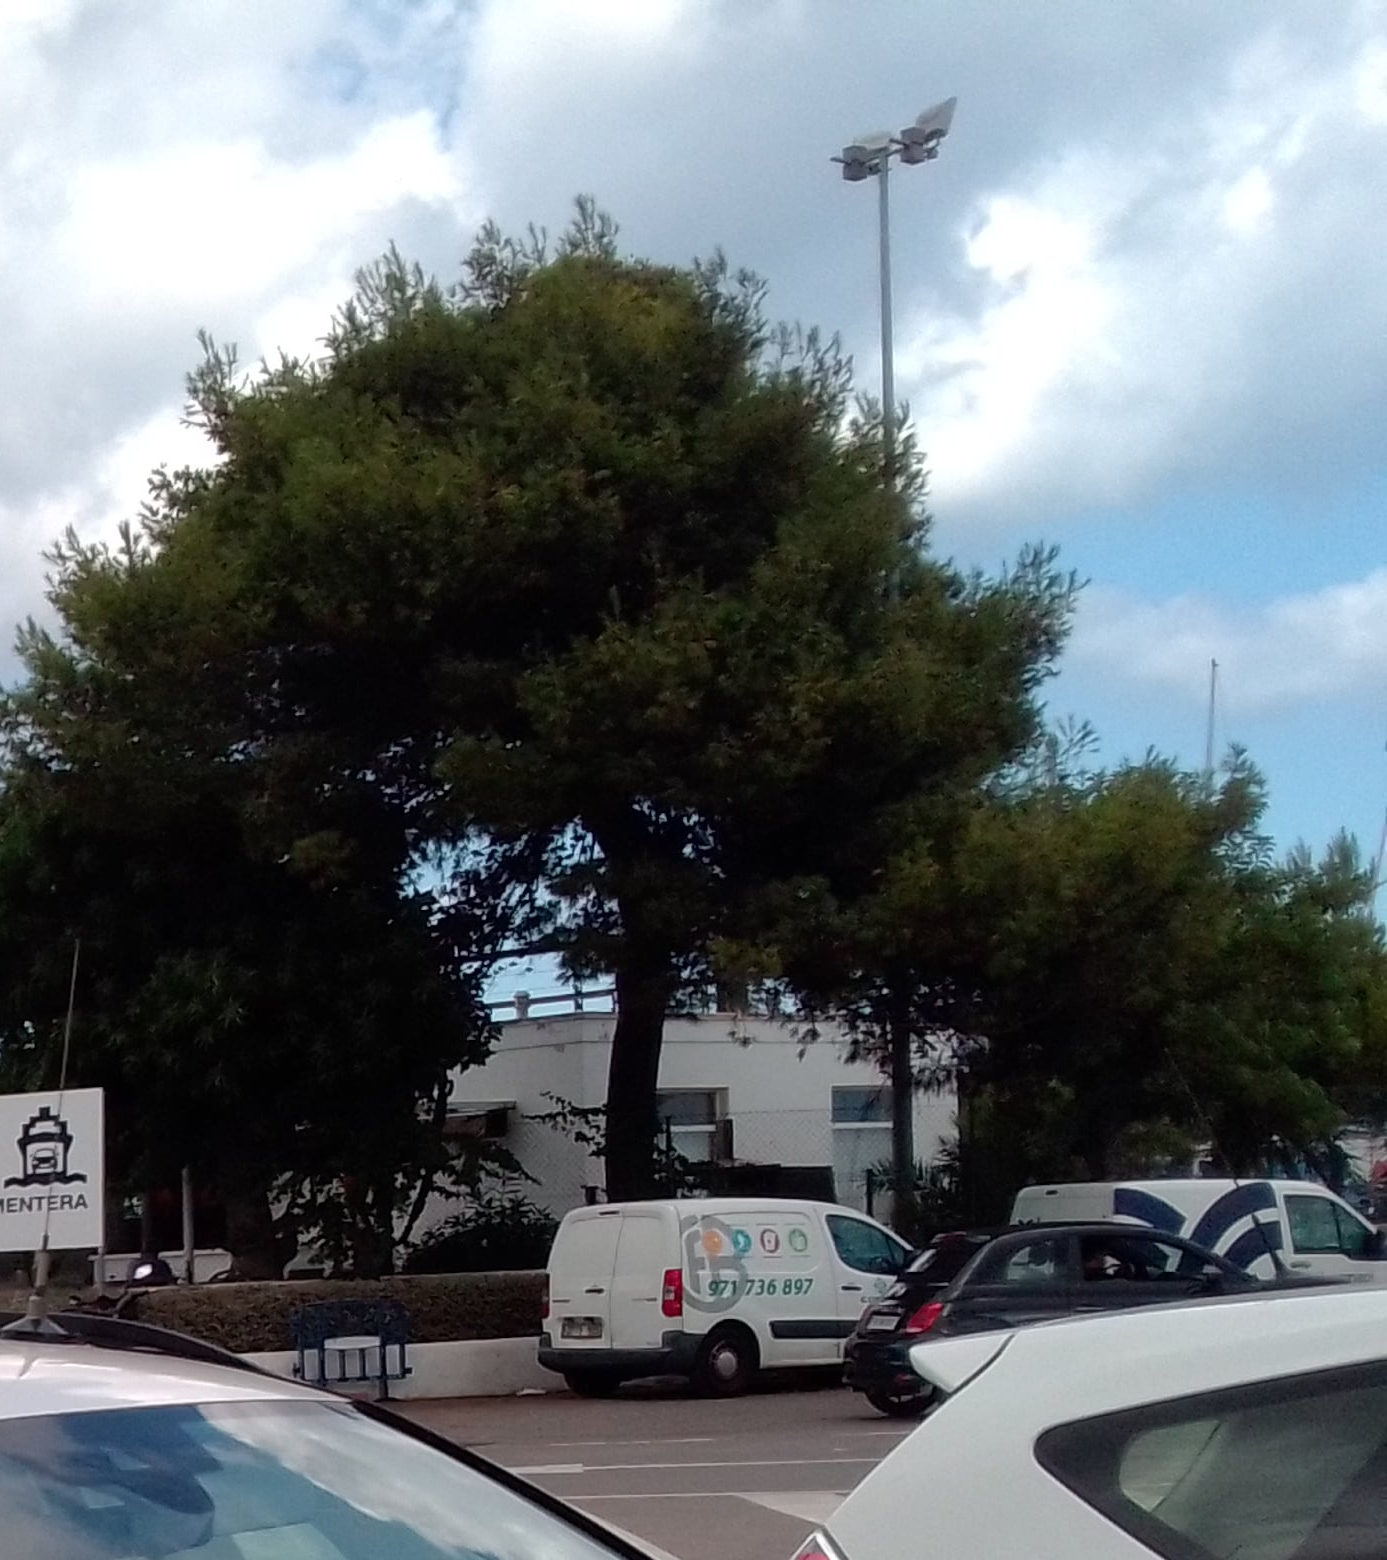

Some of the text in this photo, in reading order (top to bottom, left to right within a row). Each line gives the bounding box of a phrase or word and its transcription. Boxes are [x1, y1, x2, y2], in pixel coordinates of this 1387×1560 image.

[708, 1279, 814, 1297] 971 736 897
